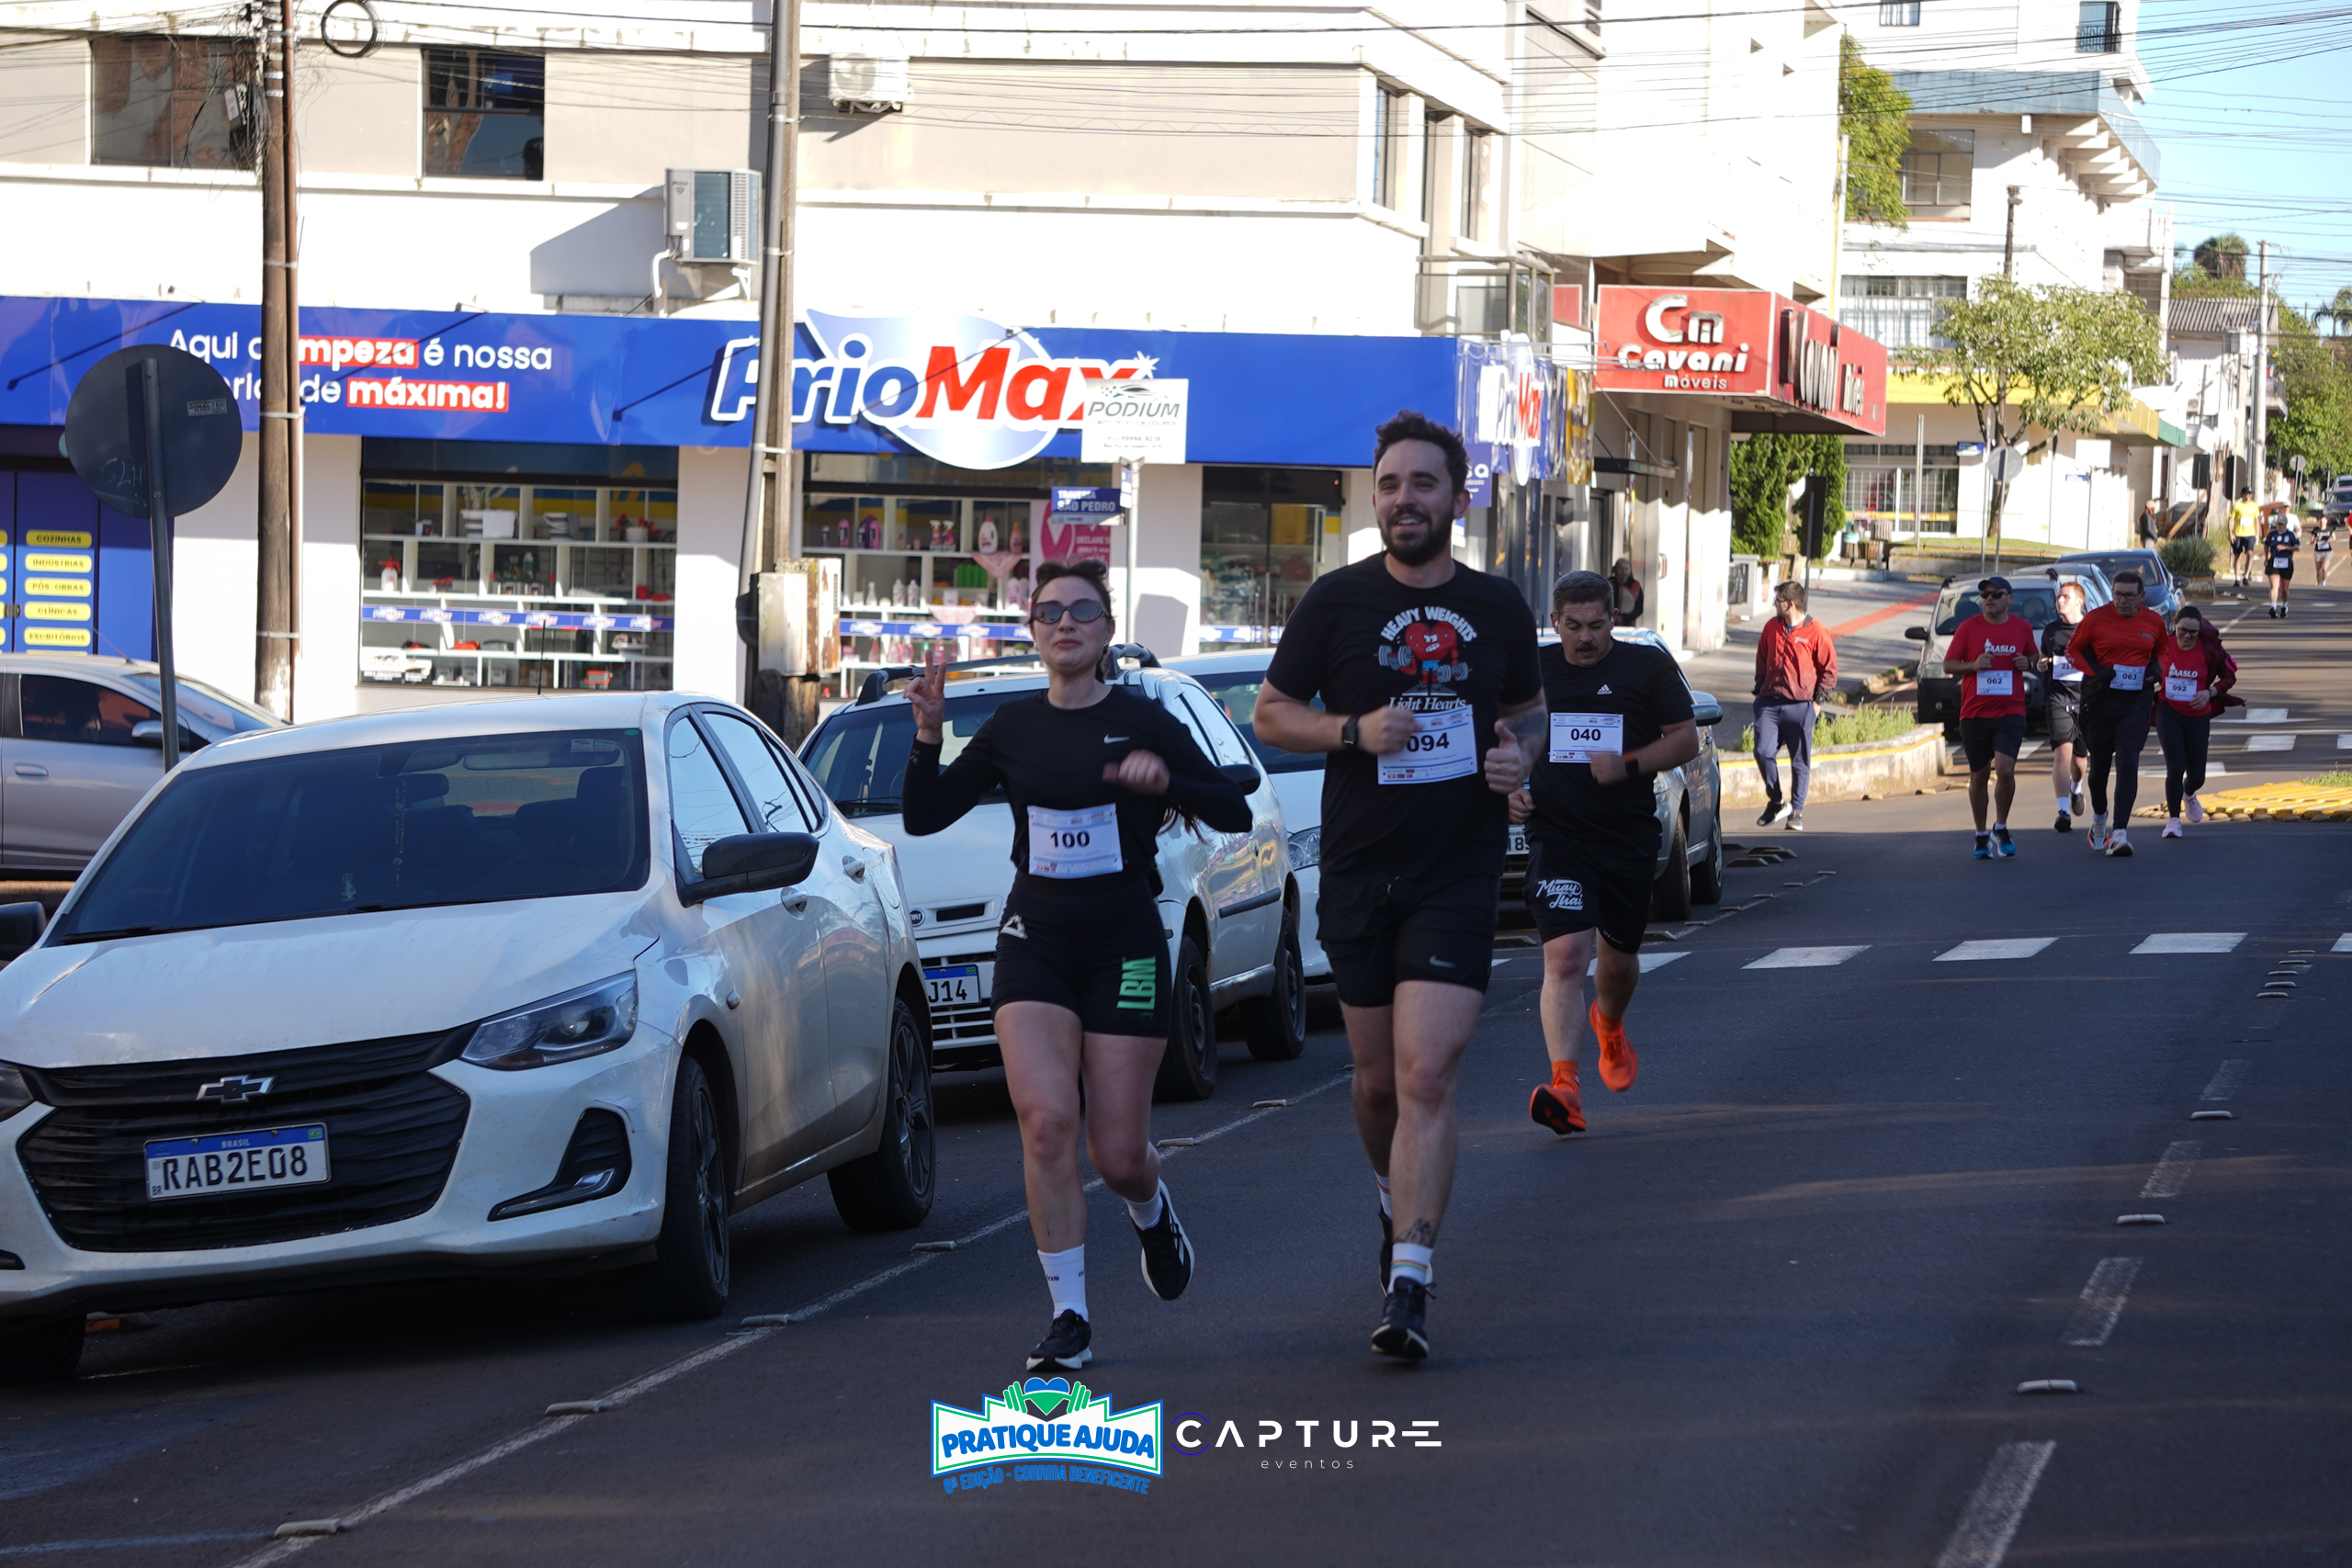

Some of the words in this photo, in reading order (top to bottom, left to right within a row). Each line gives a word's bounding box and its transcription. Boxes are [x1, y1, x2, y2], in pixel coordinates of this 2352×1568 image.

[170, 329, 238, 363] Aqui
[298, 338, 413, 371] mpeza
[424, 337, 444, 366] é
[454, 344, 552, 370] nossa
[348, 376, 507, 410] máxima!
[1087, 401, 1181, 418] PODIUM
[1080, 501, 1116, 513] PEDRO
[36, 534, 82, 544] COZINHAS
[38, 604, 78, 616] CLÍNICAS
[1380, 607, 1420, 641] HEAVY
[1424, 606, 1477, 642] WEIGHTS
[1423, 696, 1467, 711] Hearts
[1406, 732, 1450, 752] 094
[1570, 728, 1601, 741] 040
[1050, 830, 1091, 849] 100
[1535, 878, 1583, 897] Muay
[1549, 893, 1583, 909] Thai
[220, 1138, 251, 1149] BRASIL
[163, 1145, 308, 1191] RAB2E08
[152, 1185, 163, 1196] BR
